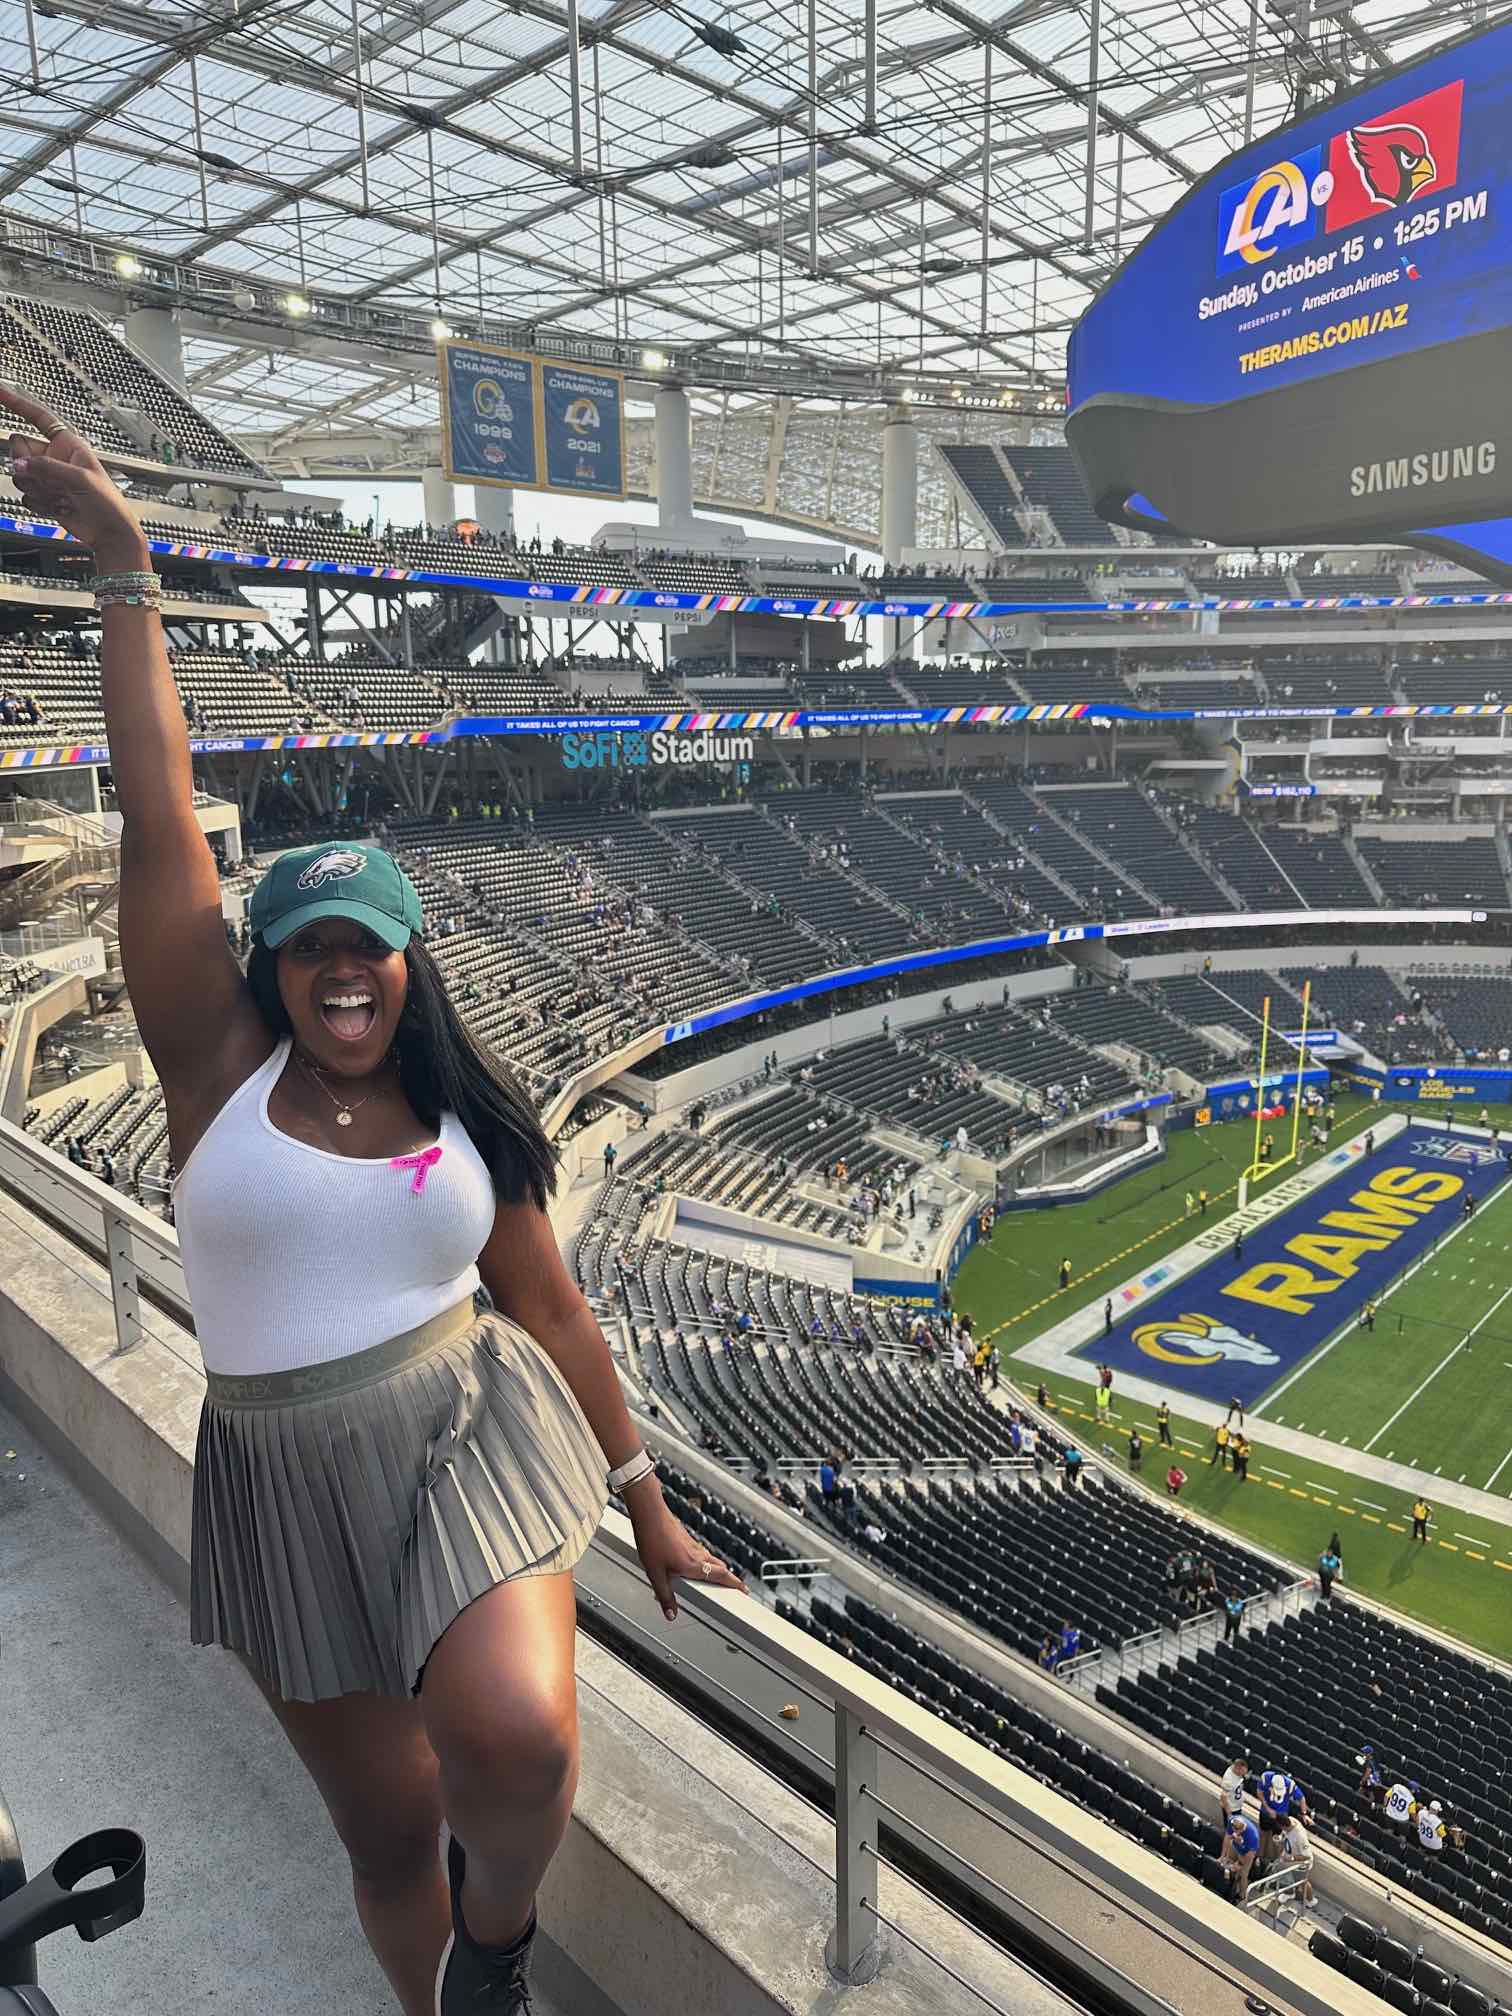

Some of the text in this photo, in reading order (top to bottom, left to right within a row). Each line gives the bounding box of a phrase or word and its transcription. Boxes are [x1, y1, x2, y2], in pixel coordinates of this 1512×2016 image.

[1198, 190, 1488, 320] Sunday, October 15 1:25 PM
[1238, 311, 1280, 333] PRESENTED
[1281, 307, 1292, 319] BY
[1239, 303, 1409, 374] THERAMS.COM/AZ
[454, 359, 527, 383] CHAMPIONS
[549, 378, 614, 398] CHAMPIONS
[474, 423, 512, 440] 1999
[567, 438, 601, 454] 2021
[1350, 441, 1496, 497] SAMSUNG
[569, 606, 599, 617] PEPSI
[673, 612, 704, 623] PEPSI
[205, 741, 244, 750] CANCER
[562, 731, 754, 768] SoFi Stadium
[1195, 1177, 1318, 1249] CRUCIAL CATCH
[1219, 1166, 1464, 1315] RAMS
[1390, 1793, 1407, 1812] 99
